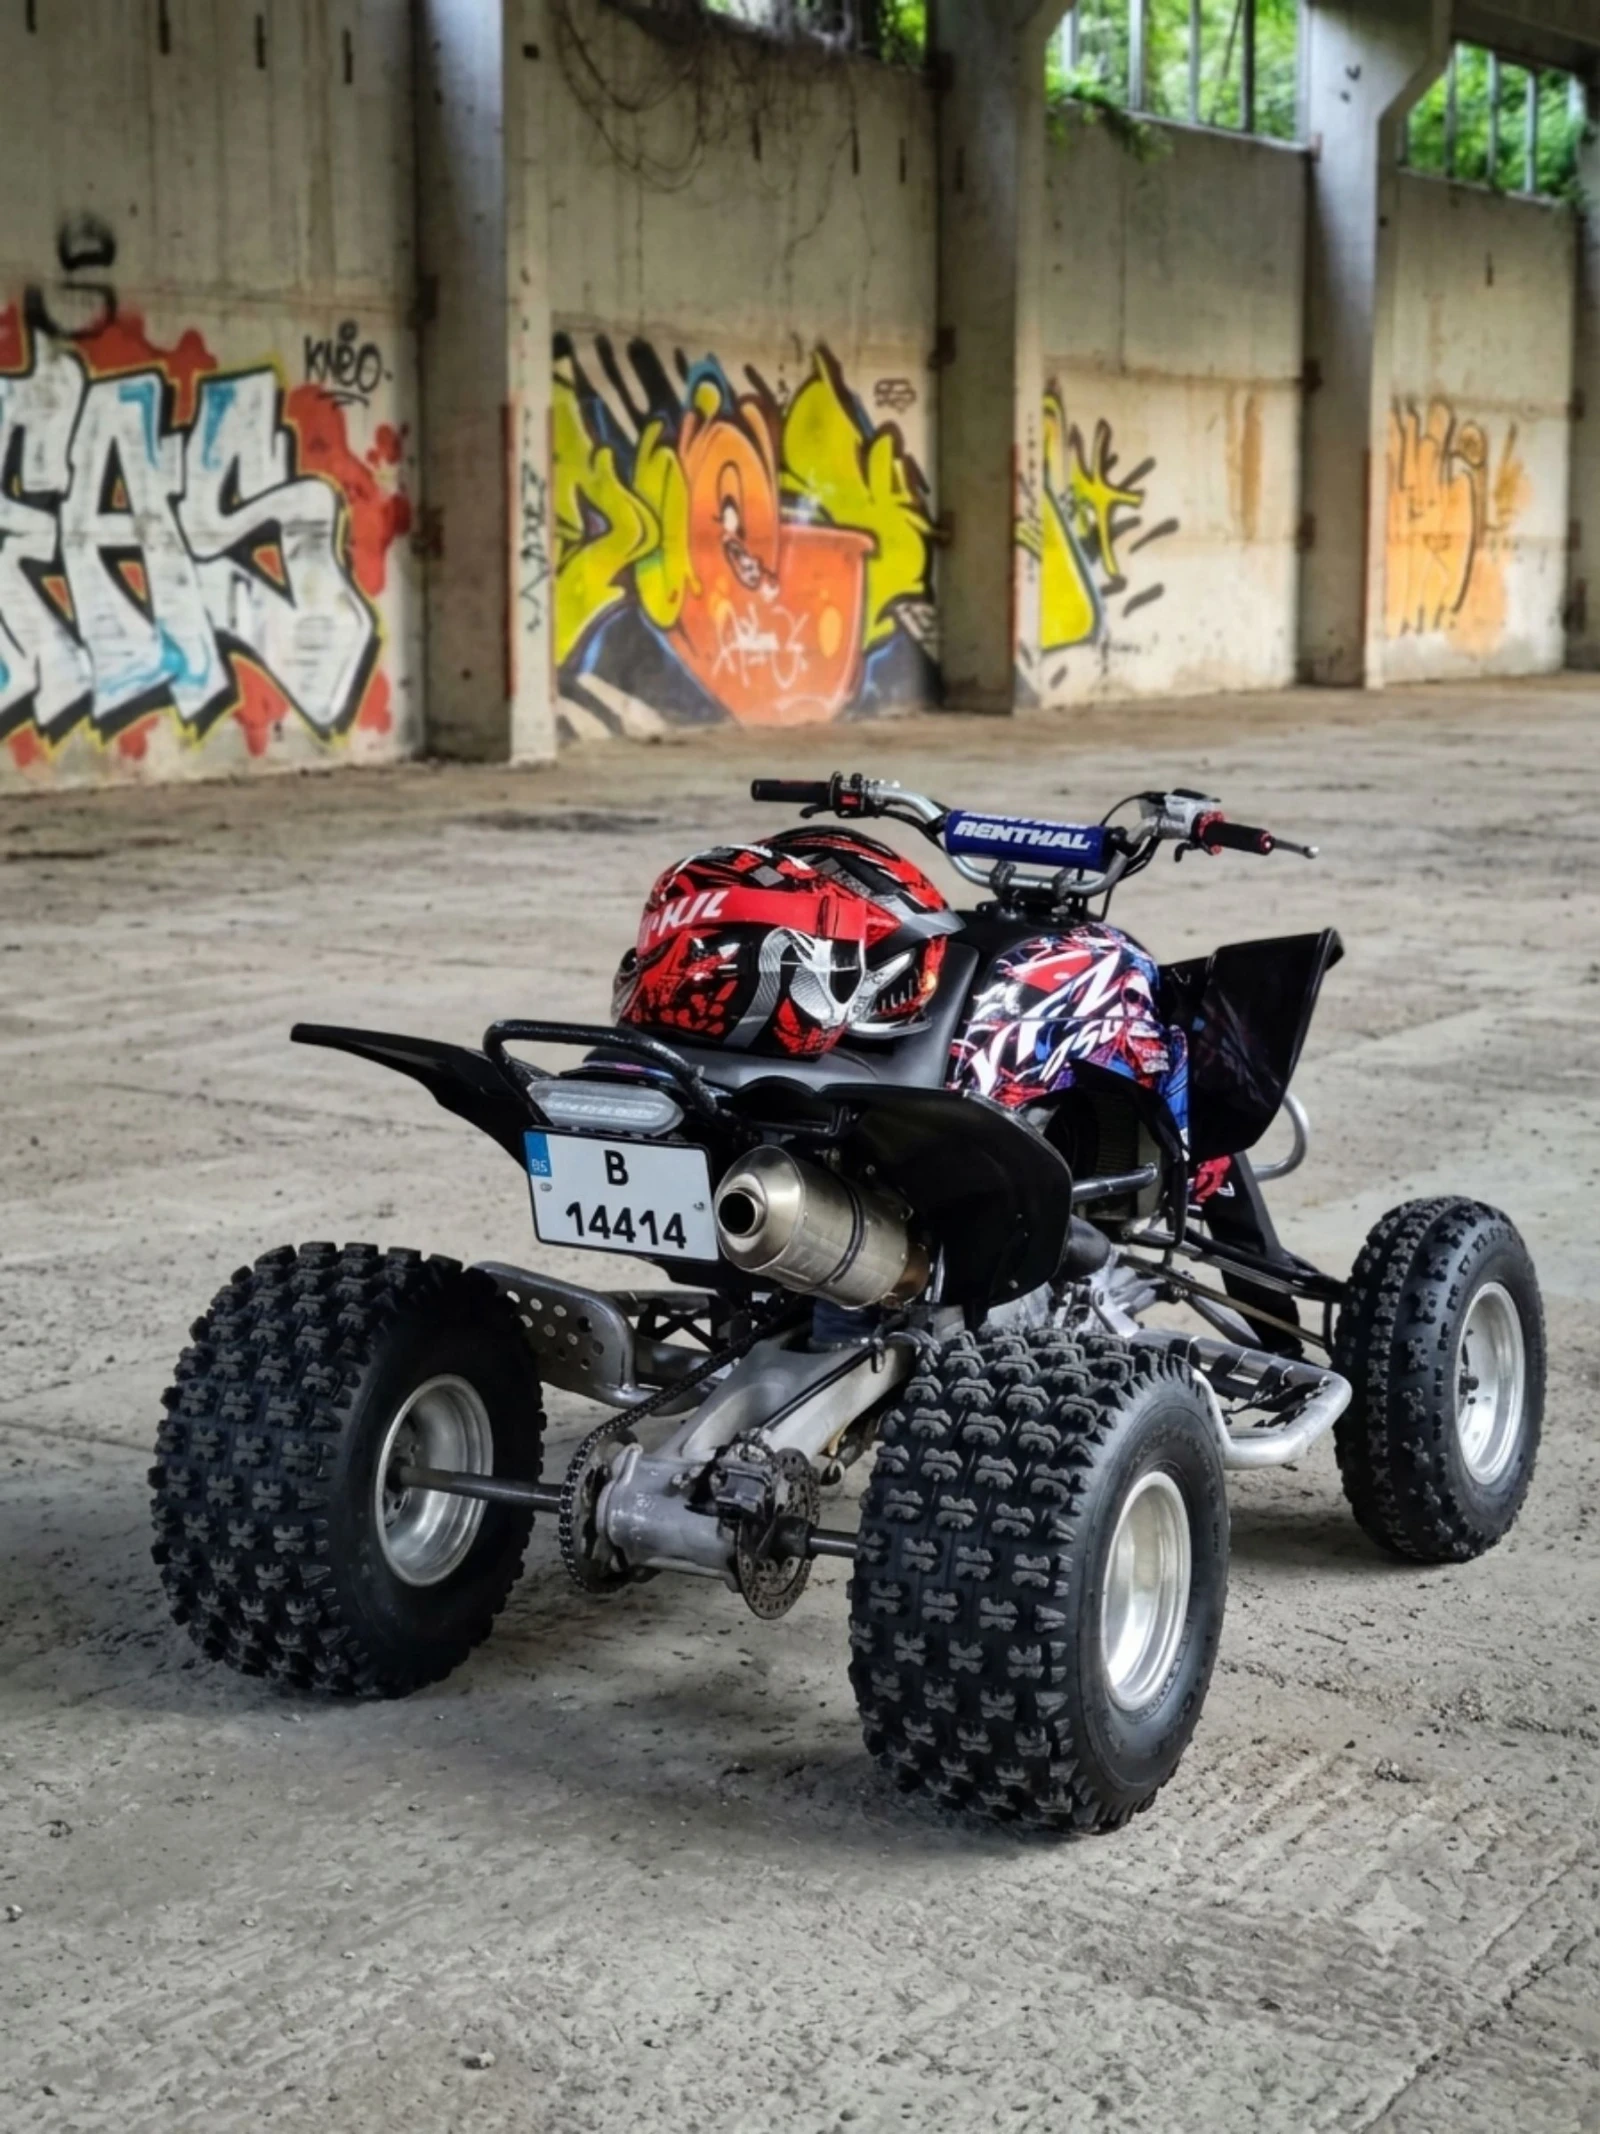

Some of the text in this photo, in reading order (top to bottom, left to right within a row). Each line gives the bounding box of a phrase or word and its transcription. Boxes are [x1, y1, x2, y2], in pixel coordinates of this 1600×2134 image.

[953, 820, 1092, 850] RENTHAL
[604, 1149, 630, 1186] B
[565, 1201, 687, 1250] 14414
